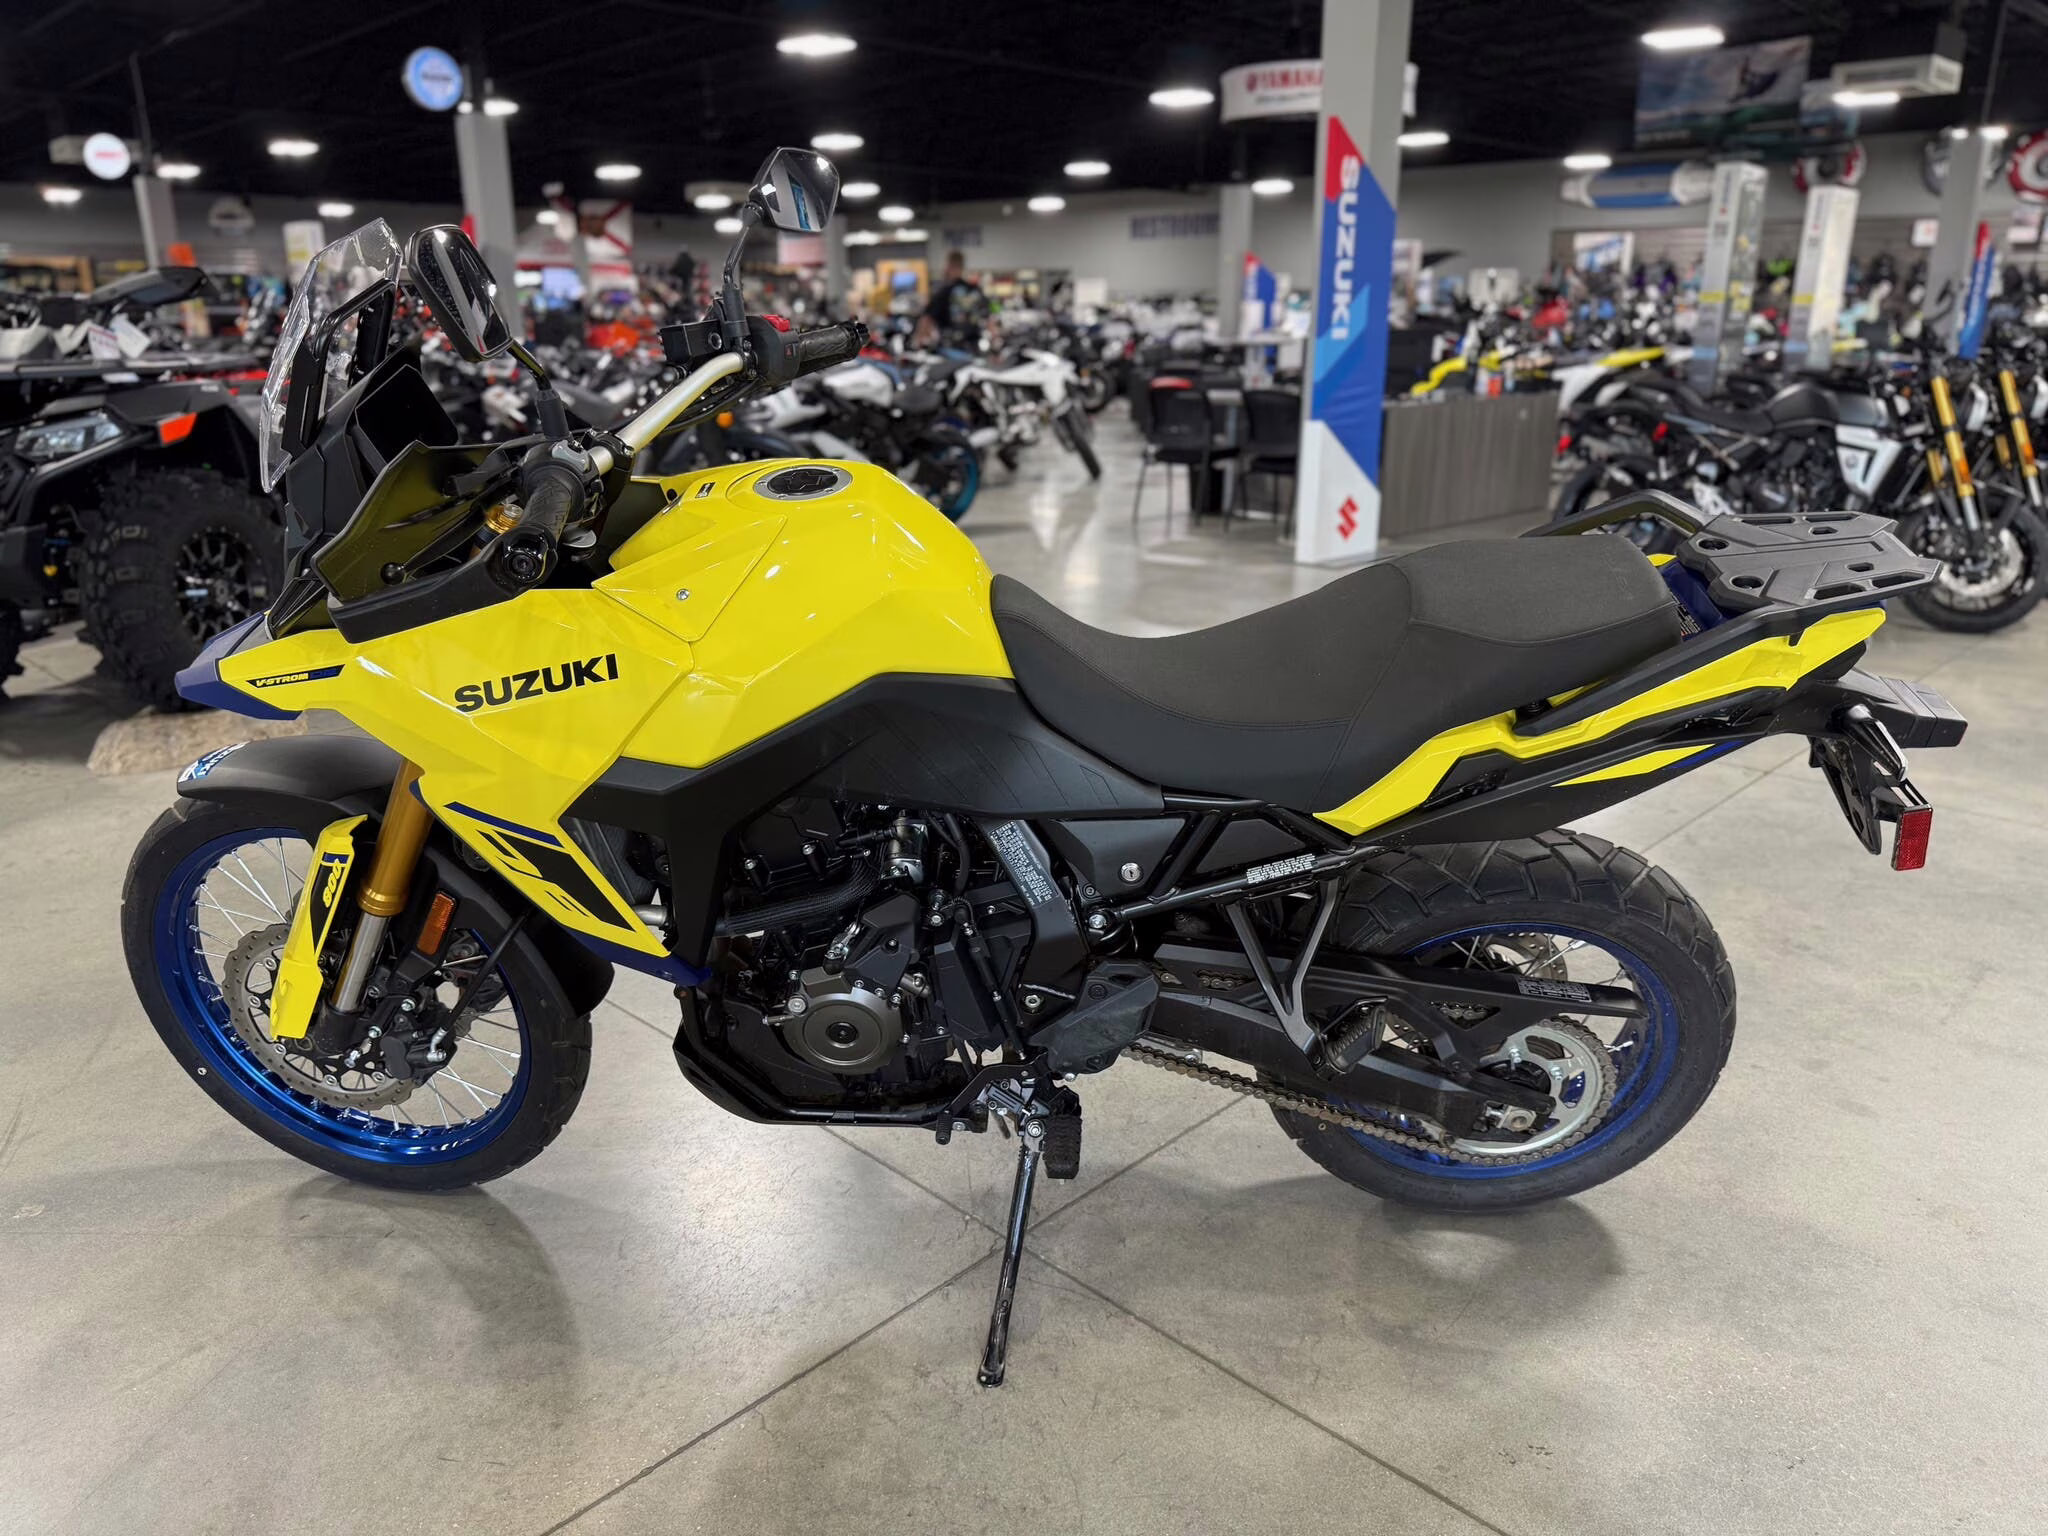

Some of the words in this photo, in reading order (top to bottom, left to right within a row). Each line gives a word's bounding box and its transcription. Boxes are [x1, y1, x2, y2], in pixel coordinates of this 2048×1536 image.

[1330, 154, 1361, 340] SUZUKI
[256, 672, 309, 688] V-STROM
[454, 653, 619, 713] SUZUKI
[322, 858, 342, 909] 800
